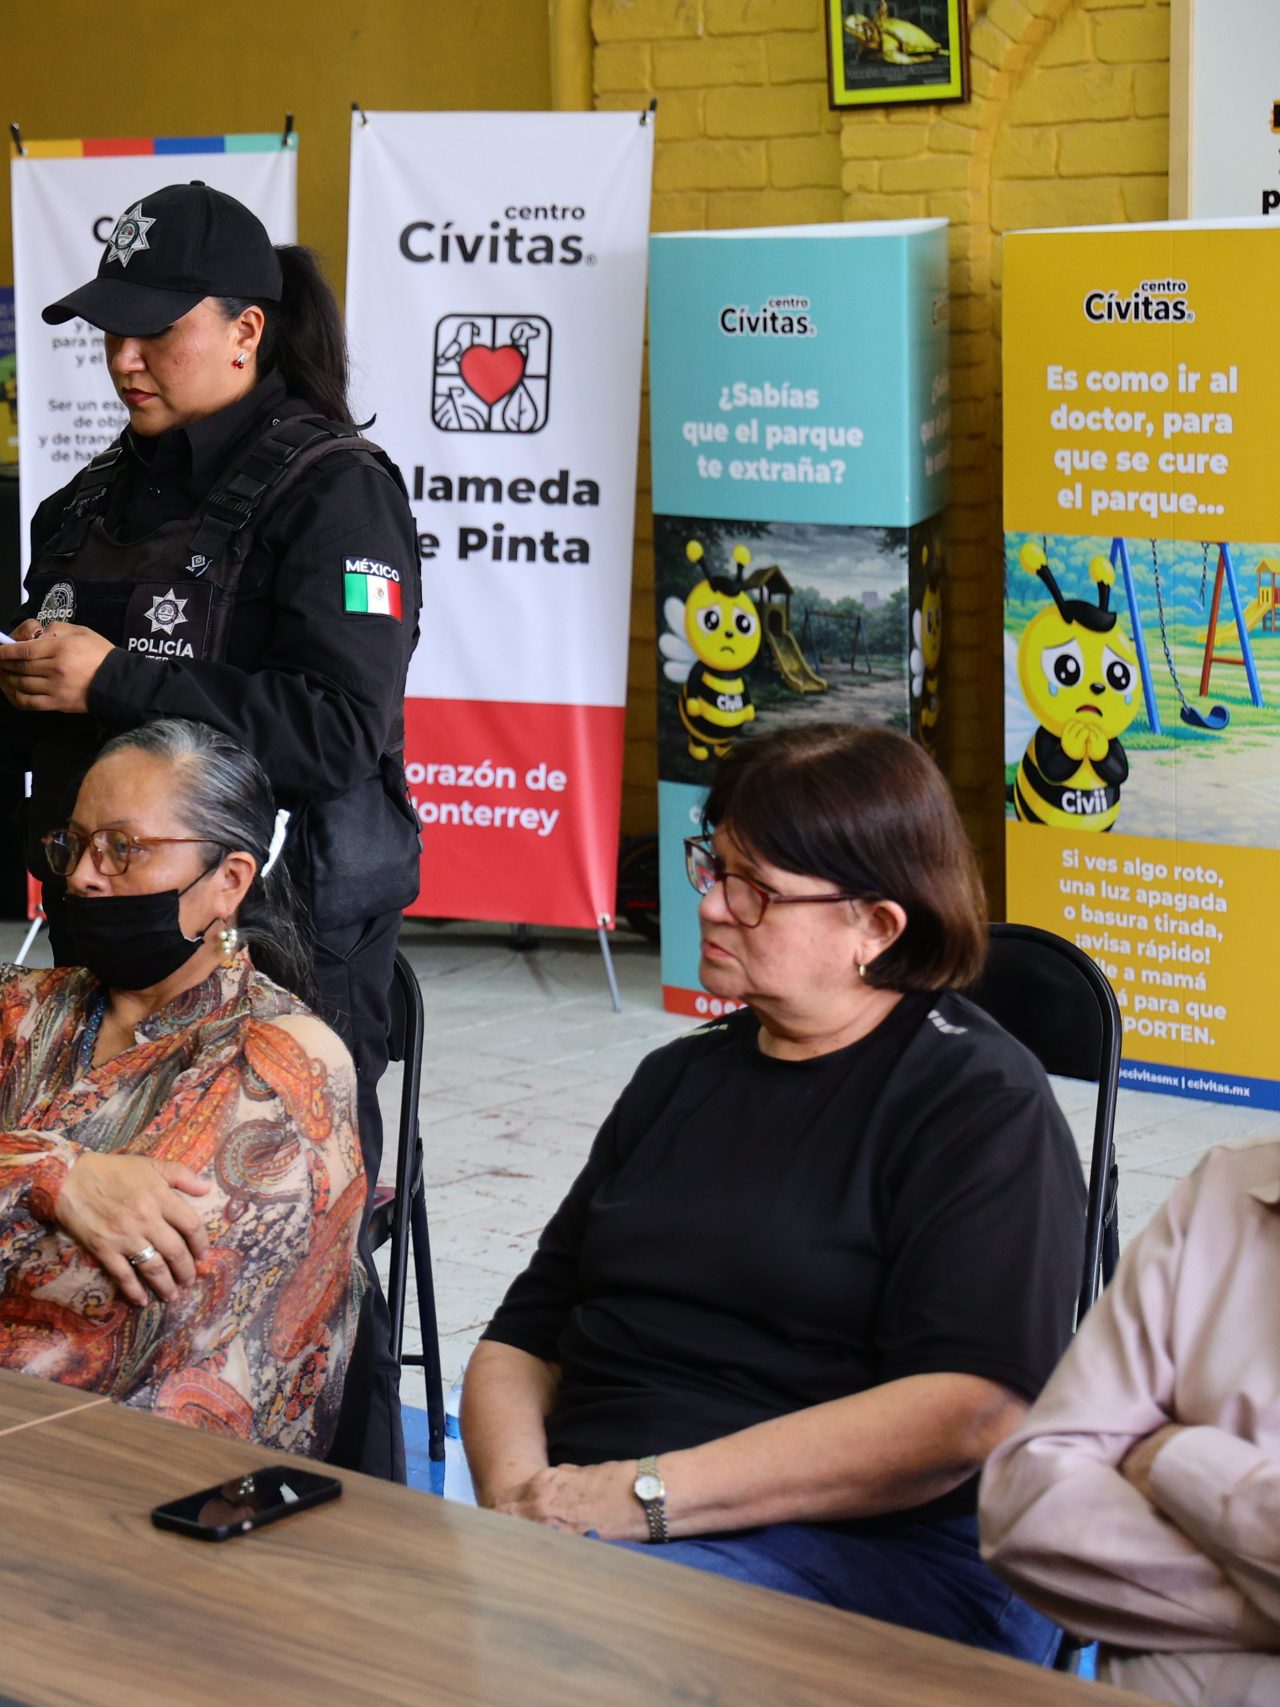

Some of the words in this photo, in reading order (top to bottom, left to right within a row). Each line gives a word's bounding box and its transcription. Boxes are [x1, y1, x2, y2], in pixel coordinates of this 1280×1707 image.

[505, 204, 585, 220] centro
[1141, 280, 1186, 292] centro
[769, 297, 809, 308] centro
[52, 337, 87, 350] para
[1047, 364, 1078, 391] Es
[1085, 370, 1169, 393] como
[1177, 362, 1200, 393] ir
[1209, 365, 1238, 393] al
[48, 400, 72, 411] Ser
[77, 401, 97, 411] un
[718, 382, 820, 411] ¿Sabías
[73, 416, 93, 428] de
[1050, 402, 1154, 438] doctor,
[1163, 411, 1233, 439] para
[38, 436, 48, 448] y
[52, 433, 71, 445] de
[682, 420, 729, 447] que
[735, 419, 758, 444] el
[765, 424, 864, 453] parque
[51, 450, 71, 462] de
[1054, 448, 1108, 476] que
[1116, 450, 1150, 472] se
[1158, 452, 1229, 475] cure
[697, 455, 722, 479] te
[728, 457, 847, 485] extraña?
[413, 465, 600, 506] lameda
[1057, 482, 1082, 509] el
[1091, 489, 1225, 519] parque...
[418, 532, 440, 559] e
[458, 523, 591, 564] Pinta
[345, 558, 400, 582] MÉXICO
[37, 608, 73, 620] ESCUDO
[128, 637, 194, 660] POLICÍA
[404, 758, 517, 790] orazón
[525, 762, 568, 792] de
[1061, 788, 1108, 814] Civii
[1062, 848, 1080, 868] Si
[1084, 854, 1118, 873] ves
[1123, 857, 1168, 881] algo
[1174, 865, 1224, 889] roto,
[1059, 879, 1095, 897] una
[1100, 879, 1131, 901] luz
[1136, 887, 1228, 913] apagada
[1063, 905, 1076, 920] o
[1081, 904, 1148, 930] basura
[1154, 912, 1224, 943] tirada,
[1137, 939, 1211, 965] rápido!
[1124, 967, 1135, 981] a
[1141, 968, 1207, 991] mamá
[1134, 994, 1180, 1013] para
[1185, 1000, 1227, 1021] que
[1124, 1016, 1216, 1046] PORTEN.
